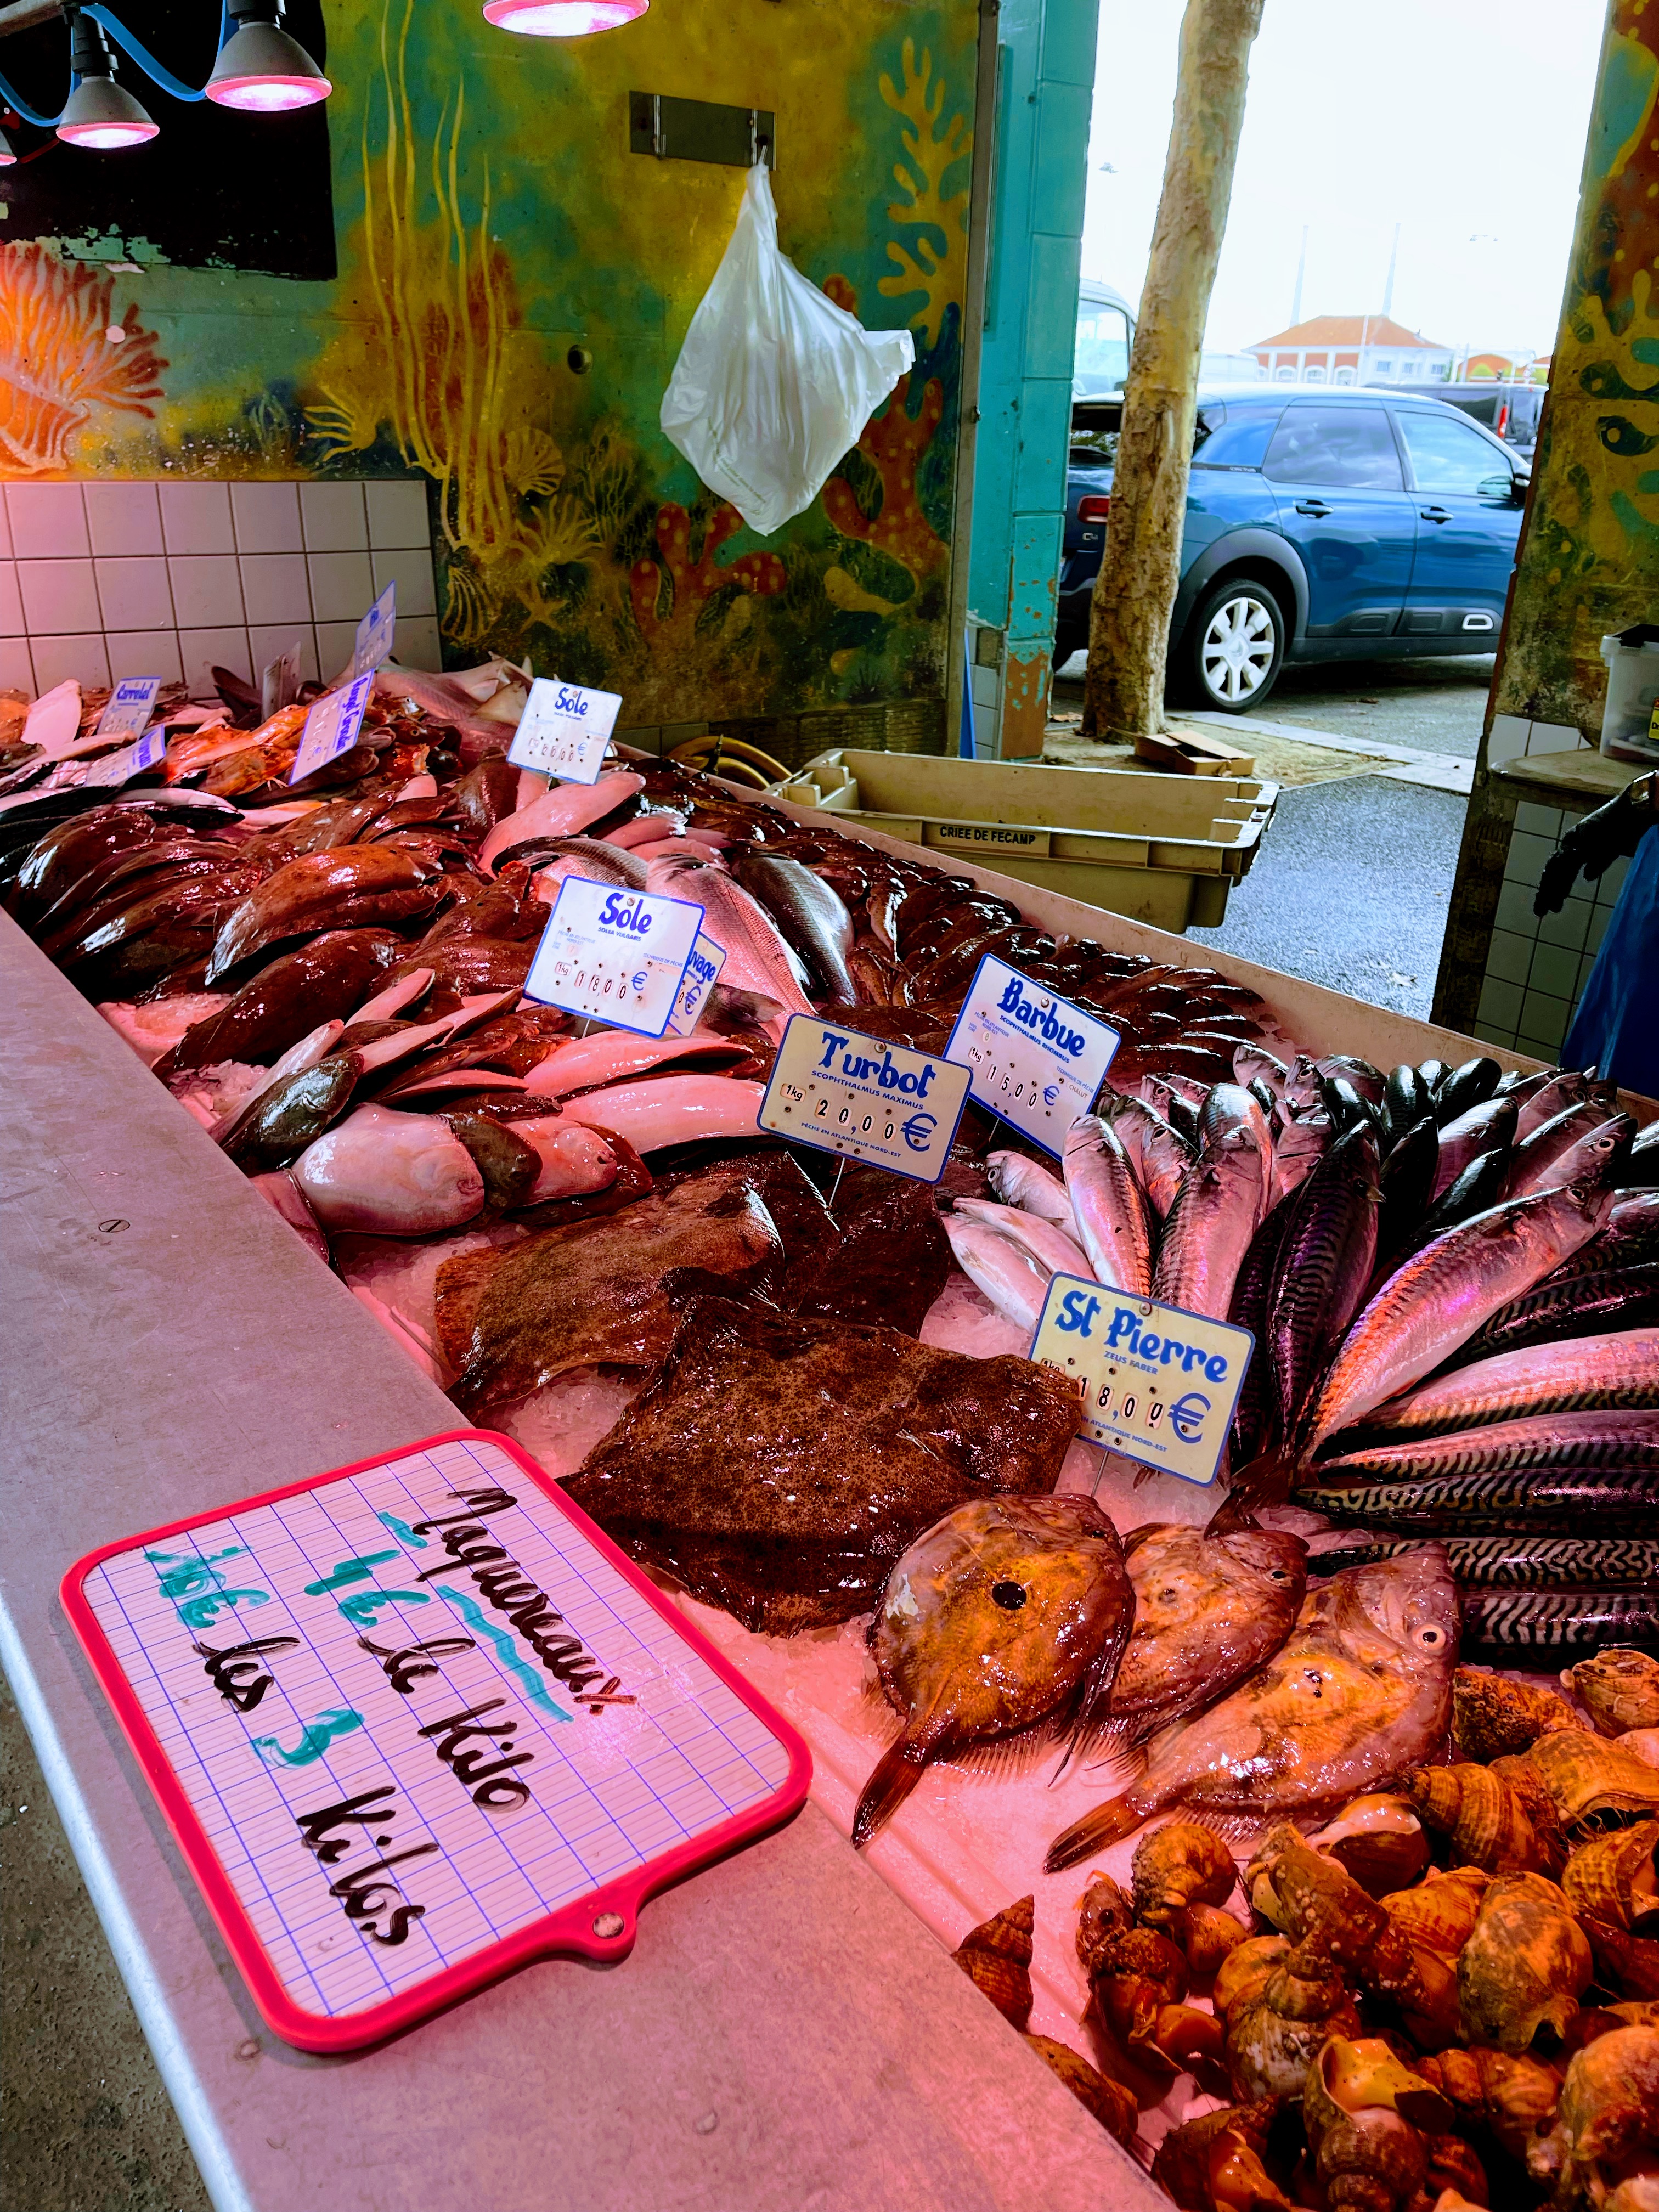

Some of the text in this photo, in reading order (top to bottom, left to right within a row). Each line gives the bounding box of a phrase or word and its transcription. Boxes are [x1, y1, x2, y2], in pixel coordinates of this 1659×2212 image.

[554, 687, 589, 716] Sole
[940, 826, 1036, 845] CRIEE DE FECAMP
[598, 892, 652, 934] Sole
[598, 927, 641, 942] SOLEA VULGARIS
[558, 964, 569, 976] 1kg
[996, 977, 1086, 1058] Barbue
[984, 1032, 990, 1041] 8
[999, 1015, 1070, 1063] SCOPHTHALMUS RHOMBUS
[818, 1031, 936, 1098] Turbot
[972, 1047, 982, 1063] 1kg
[1056, 1065, 1077, 1082] TECHNIQUE
[786, 1084, 803, 1102] 1kg
[811, 1070, 924, 1110] SCOPHTHALMUS MAXIMUS
[1069, 1084, 1088, 1099] CHALUT
[831, 1132, 869, 1148] ATLANTIQUE
[870, 1144, 901, 1158] NORD-EST
[1054, 1290, 1228, 1383] St Pierre
[1103, 1350, 1159, 1375] ZEUS FABER
[1090, 1418, 1131, 1439] ATLANTIQUE
[1131, 1434, 1168, 1452] NORD-EST
[412, 1487, 637, 1716] Maquereaux
[356, 1636, 477, 1695] le
[190, 1636, 302, 1714] les
[250, 1708, 365, 1770] 3
